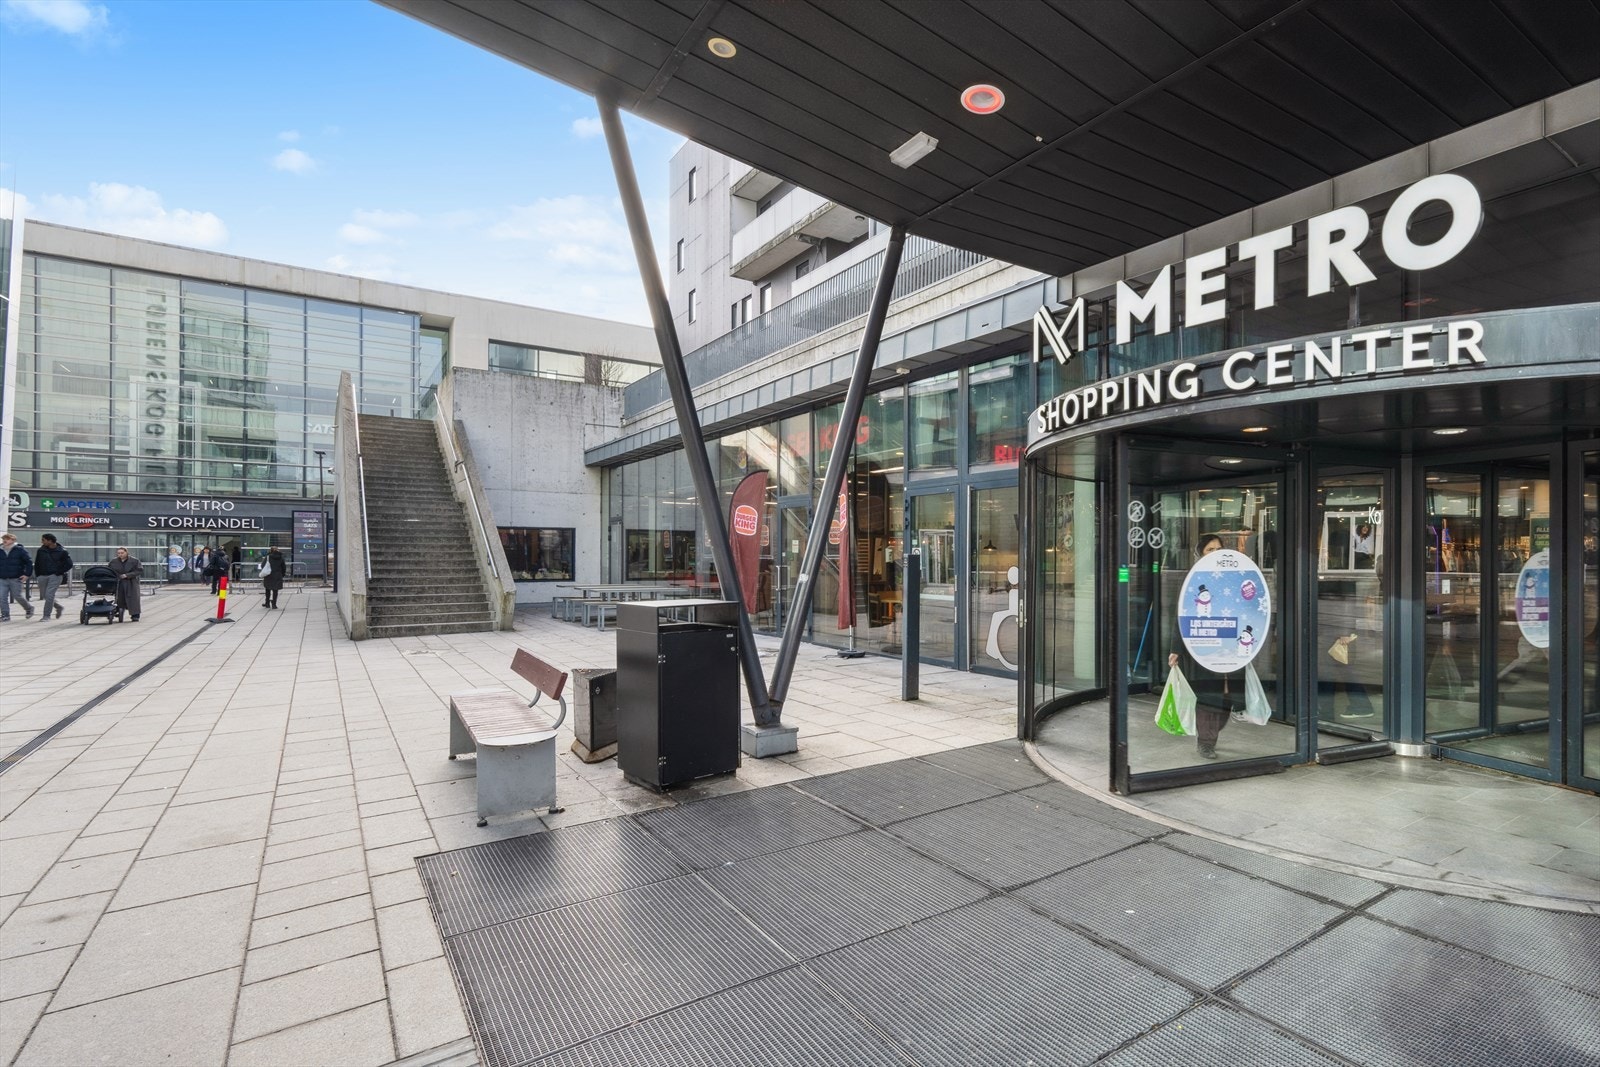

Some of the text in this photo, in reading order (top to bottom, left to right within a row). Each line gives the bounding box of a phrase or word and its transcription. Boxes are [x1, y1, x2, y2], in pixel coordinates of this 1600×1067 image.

[1116, 173, 1484, 345] METRO
[1037, 320, 1488, 434] SHOPPING CENTER
[57, 500, 112, 509] APOTEK
[176, 499, 235, 511] METRO
[8, 512, 27, 526] S
[147, 516, 260, 529] STORHANDEL
[735, 519, 756, 530] KING
[1216, 560, 1239, 568] METRO
